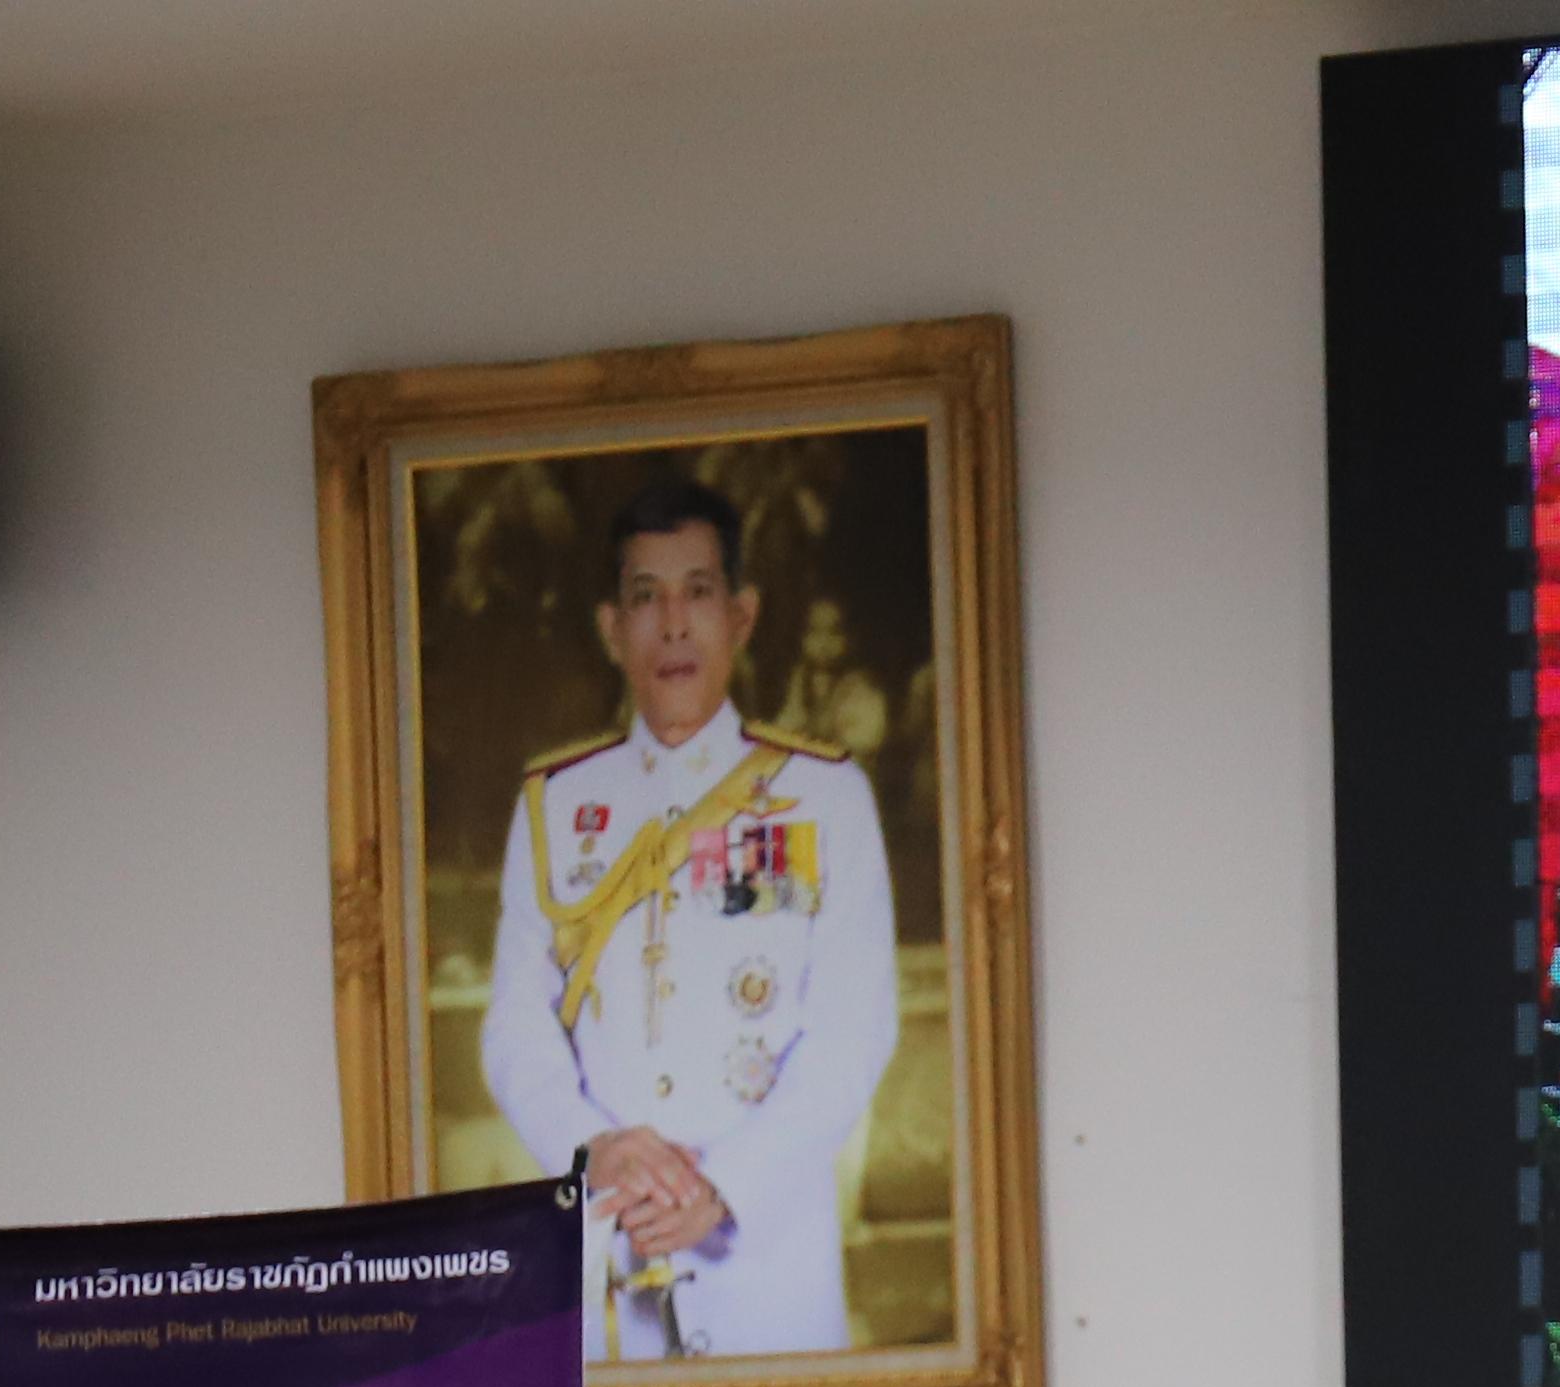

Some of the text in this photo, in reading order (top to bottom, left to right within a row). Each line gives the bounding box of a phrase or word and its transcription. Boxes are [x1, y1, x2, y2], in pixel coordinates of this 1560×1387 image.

[34, 1248, 511, 1303] มหาวิทยาลัยราชภัฏกำแพงเพชร
[37, 1309, 417, 1351] Kamphaeng Phet Rajabhat University
